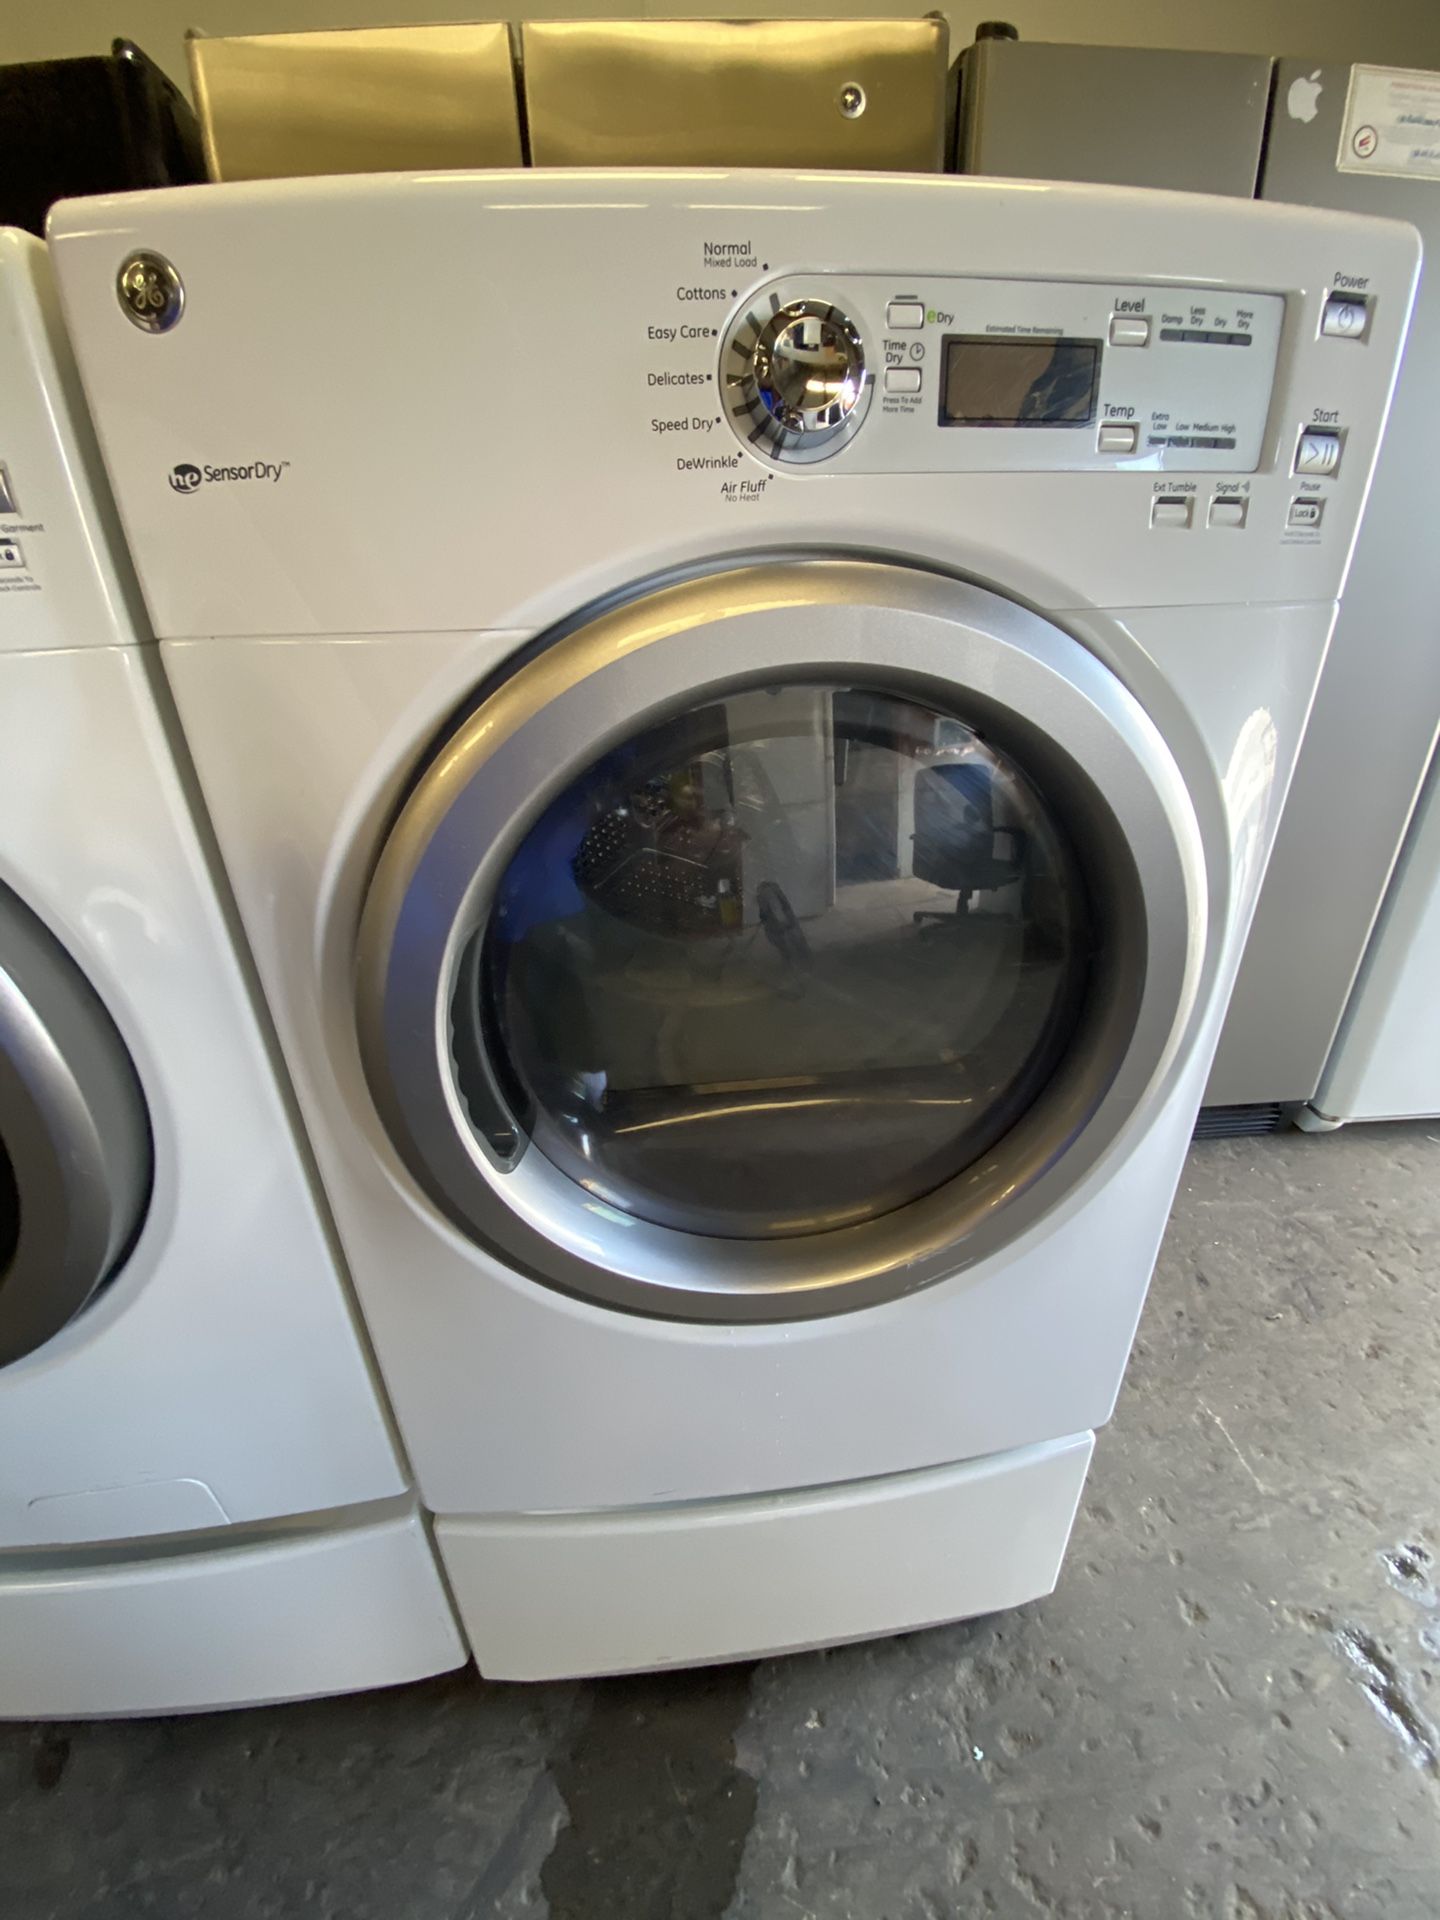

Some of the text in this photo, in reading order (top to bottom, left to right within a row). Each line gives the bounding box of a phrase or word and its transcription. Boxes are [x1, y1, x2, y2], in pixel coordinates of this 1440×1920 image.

[704, 241, 752, 256] Normal
[704, 257, 757, 268] Mixed Load
[1334, 272, 1370, 289] Power
[677, 287, 726, 300] Cottons
[1114, 298, 1145, 312] Level
[1191, 306, 1206, 316] Less
[1237, 310, 1254, 319] More
[1162, 314, 1183, 325] Damp
[1190, 315, 1203, 326] Dry
[1214, 317, 1227, 328] Dry
[1238, 319, 1250, 330] Dry
[648, 325, 710, 342] Easy Care
[986, 325, 1064, 335] Estimated Time Remaining
[883, 340, 906, 351] Time
[886, 352, 903, 365] Dry
[648, 372, 704, 386] Delicates
[1103, 404, 1135, 418] Temp
[1151, 412, 1169, 421] Extra
[1312, 408, 1339, 423] Start
[652, 417, 713, 434] Speed Dry
[1153, 422, 1167, 431] Low
[1176, 422, 1190, 431] Low
[1193, 423, 1219, 432] Medium
[1221, 424, 1236, 434] High
[677, 457, 738, 470] DeWrinkle
[720, 479, 767, 494] Air Fluff
[1153, 482, 1197, 492] Ext Tumble
[1216, 482, 1240, 495] Signal
[725, 493, 760, 502] No Heat
[1, 523, 44, 532] Garment
